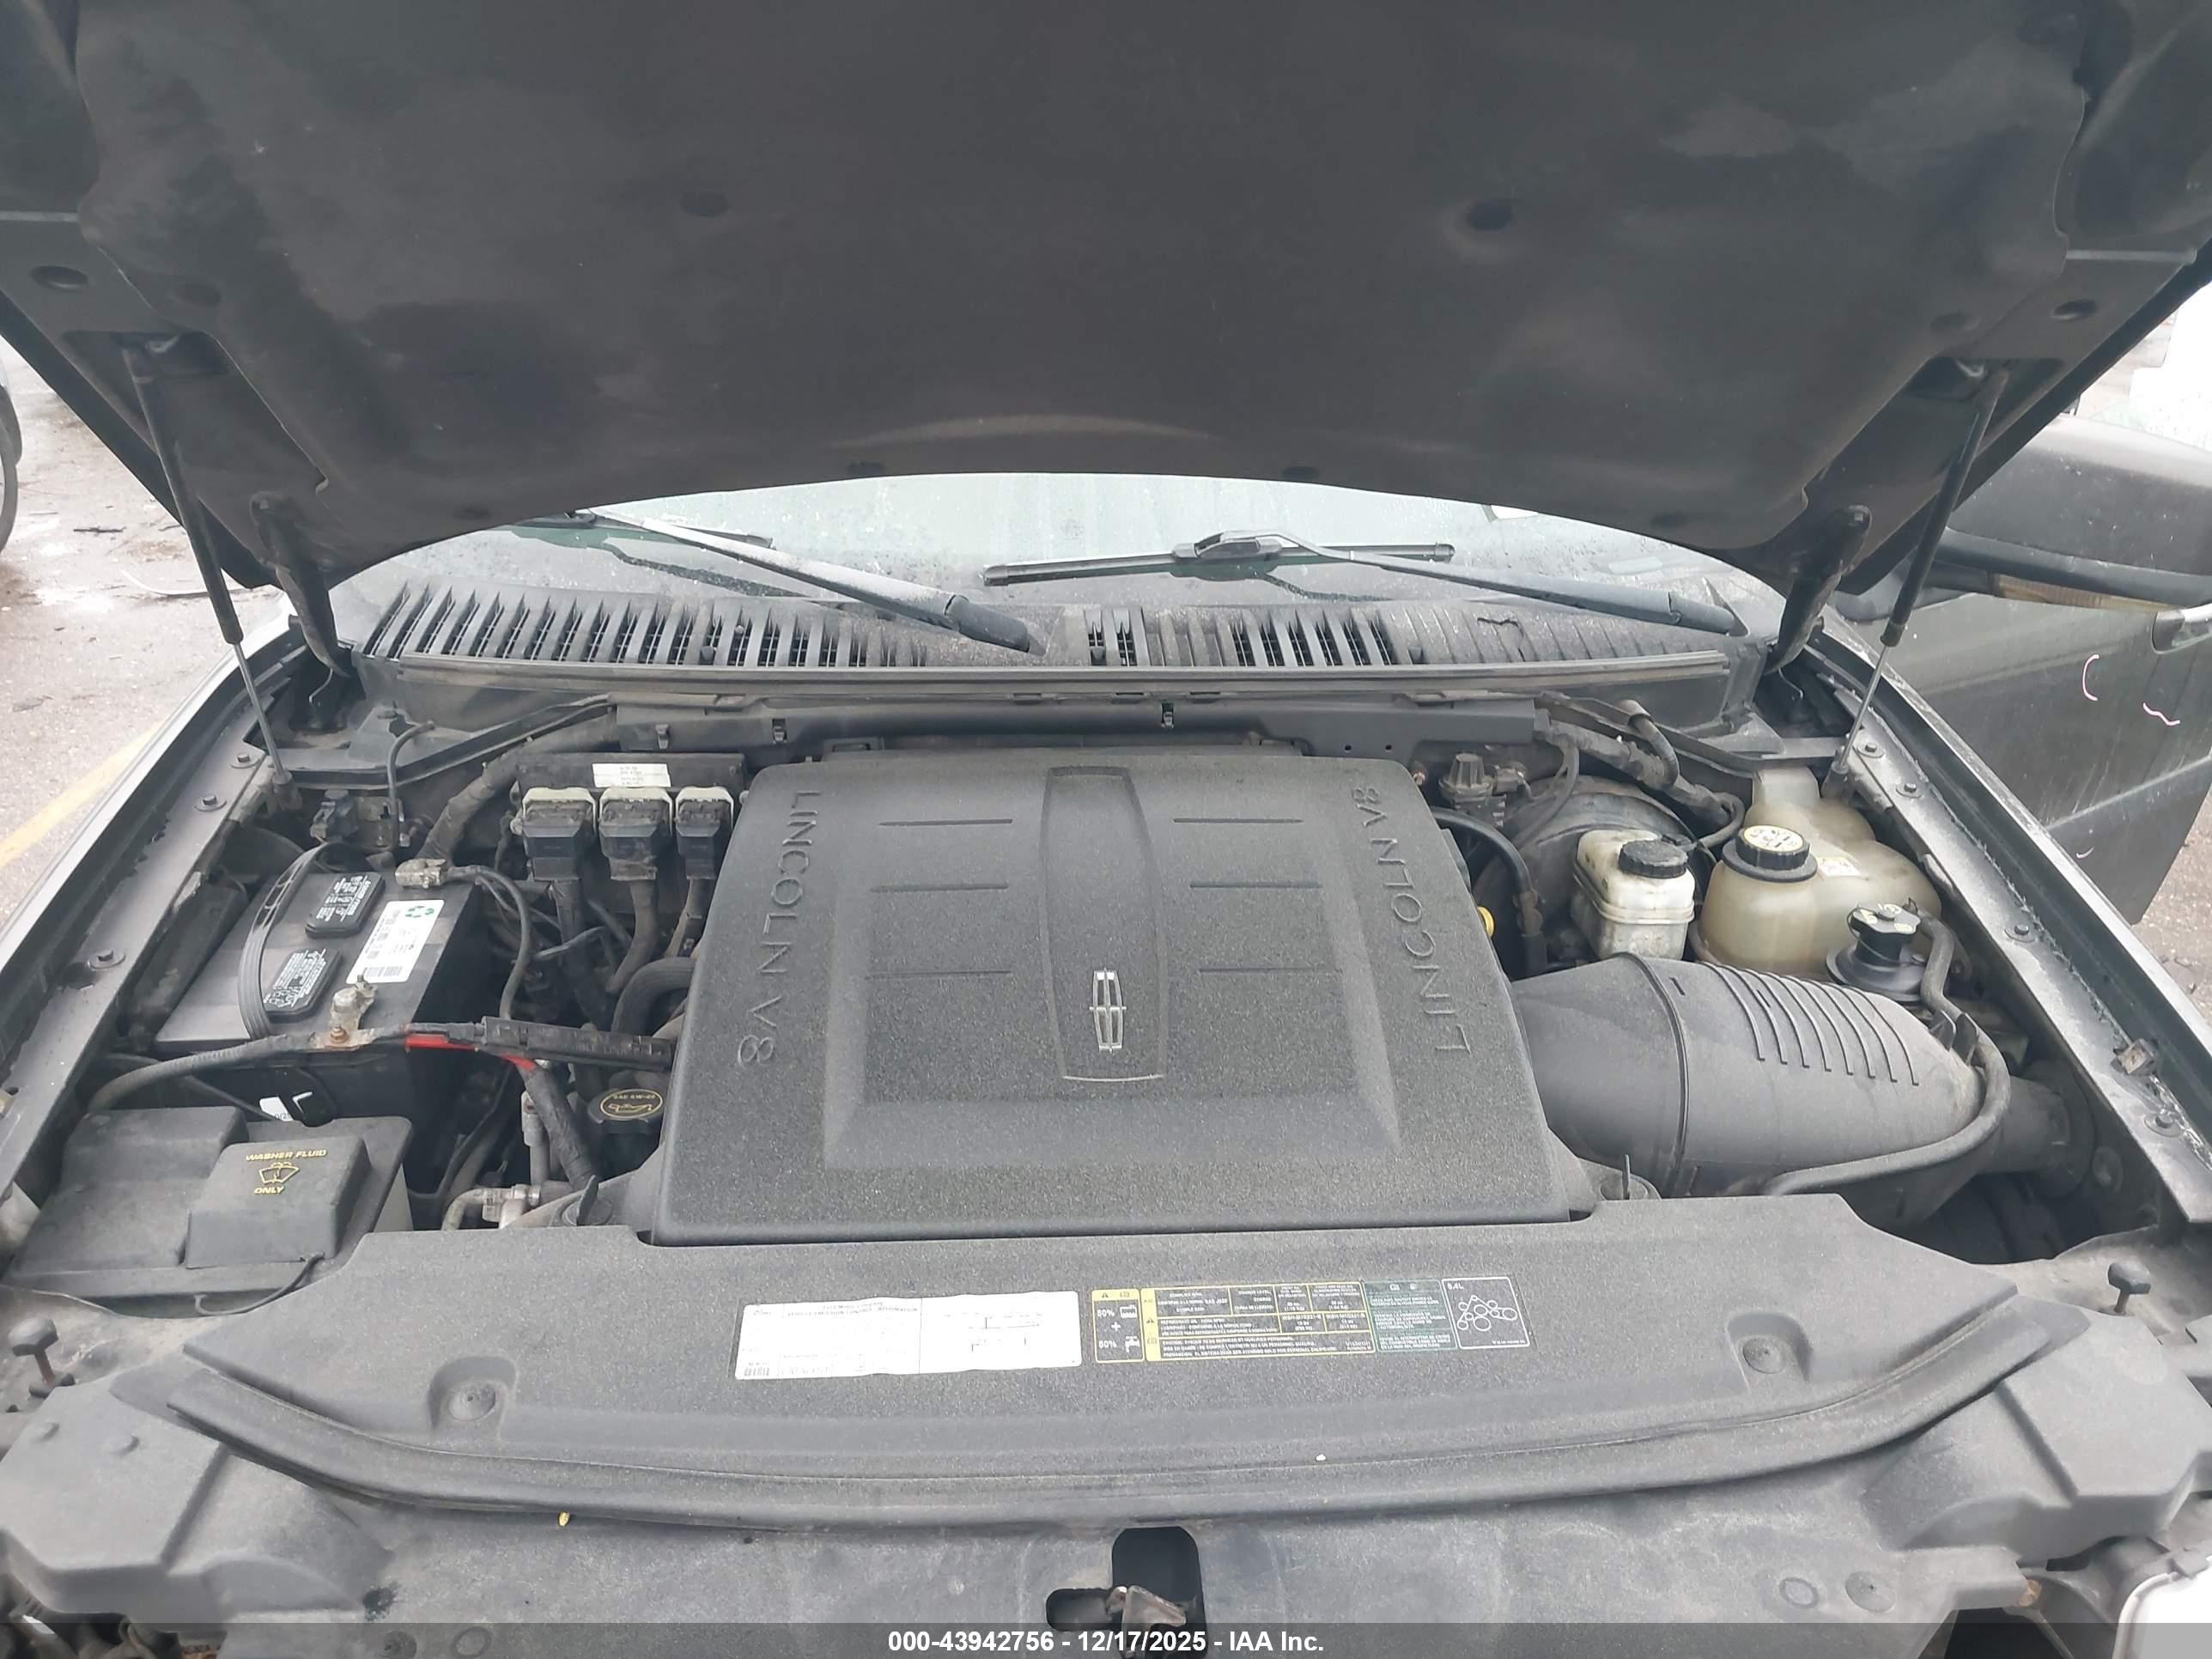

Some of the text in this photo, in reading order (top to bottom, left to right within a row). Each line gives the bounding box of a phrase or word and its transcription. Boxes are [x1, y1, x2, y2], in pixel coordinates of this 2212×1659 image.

[738, 790, 822, 1066] LINCOLN V8
[1352, 787, 1471, 1054] LINCOLN V8
[246, 1150, 327, 1161] WASHER FLUID
[253, 1185, 285, 1194] ONLY
